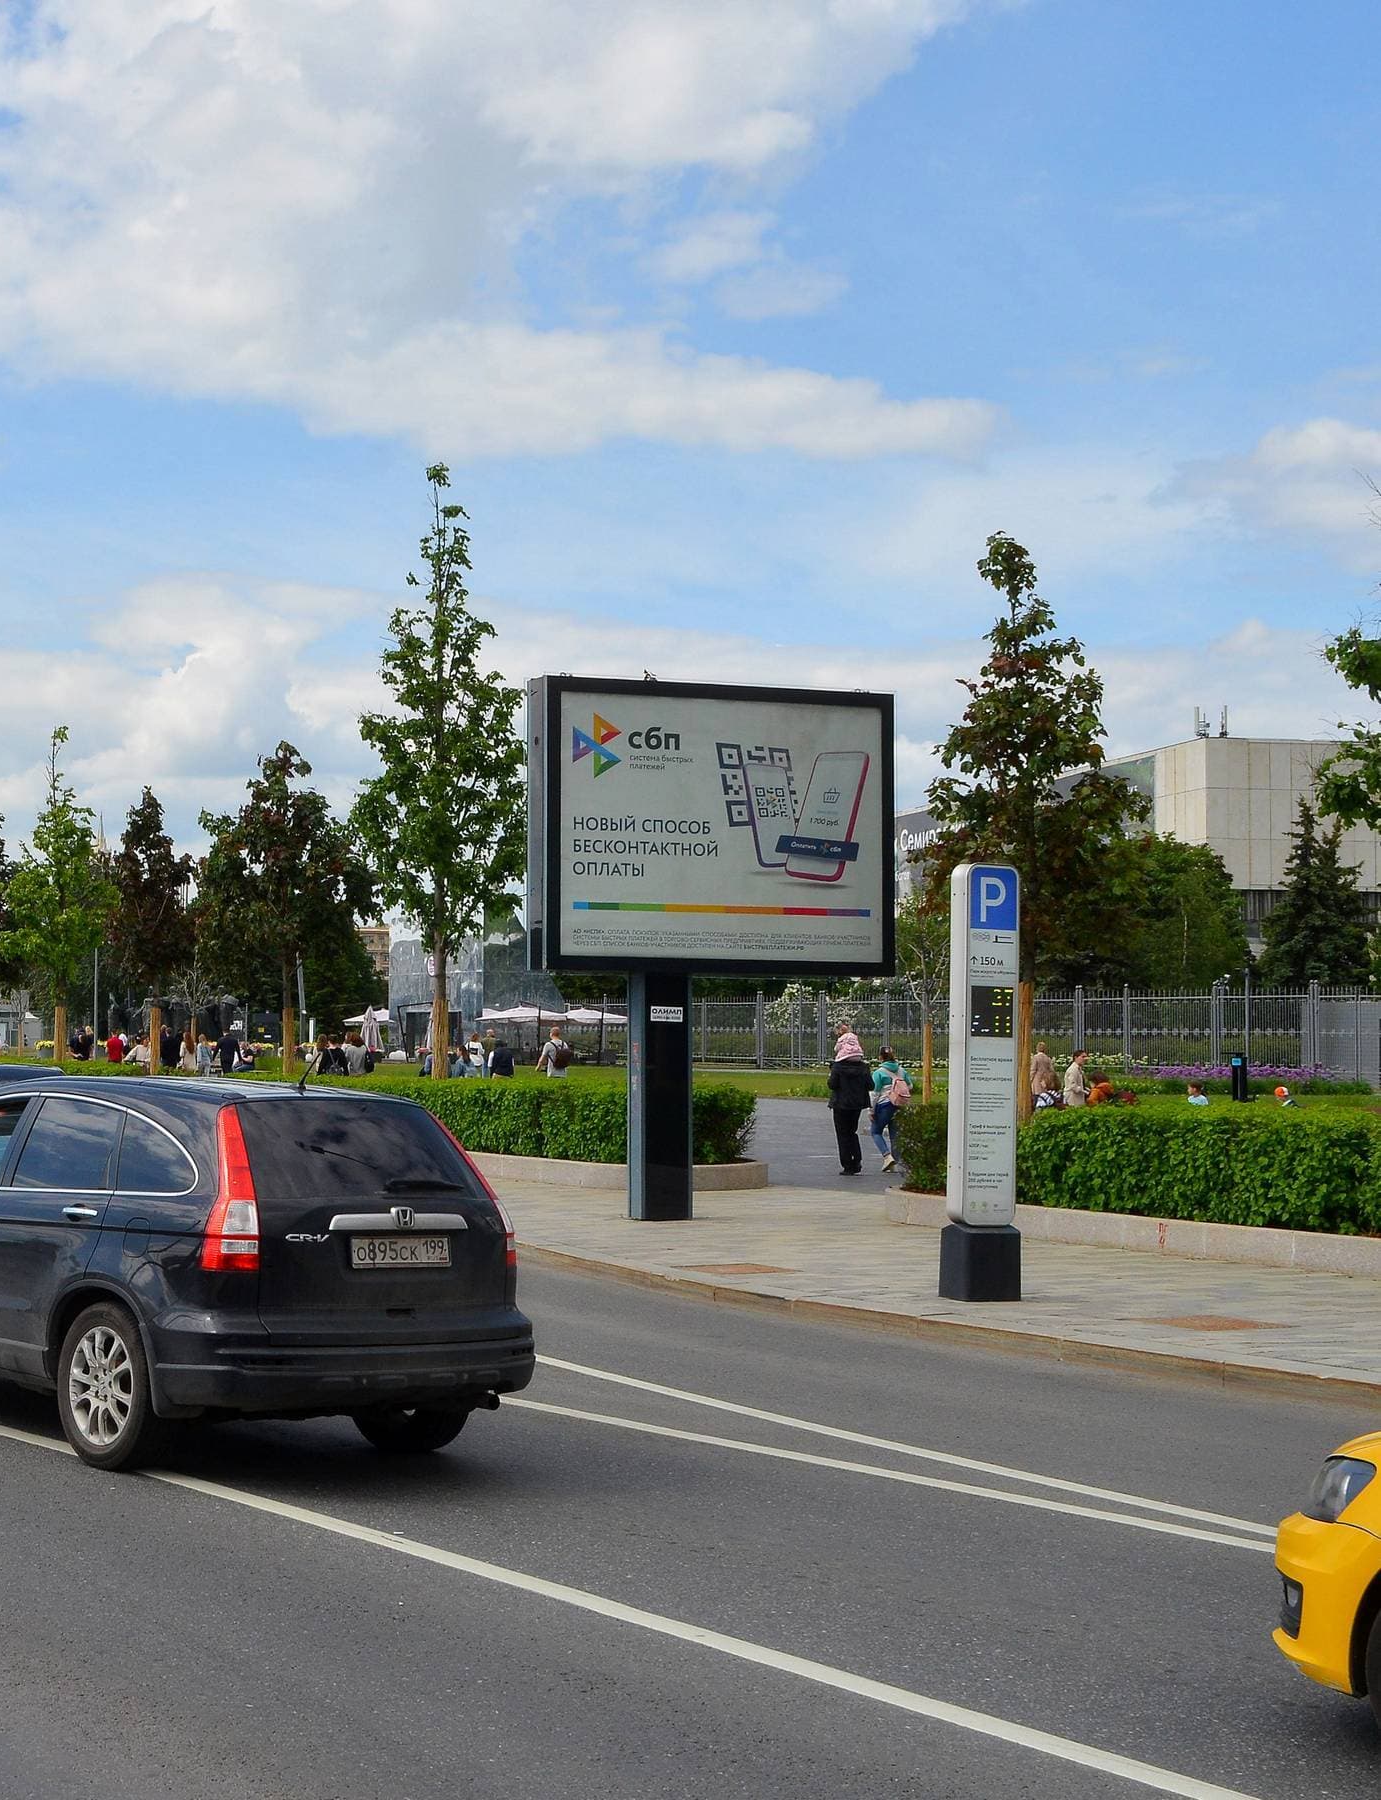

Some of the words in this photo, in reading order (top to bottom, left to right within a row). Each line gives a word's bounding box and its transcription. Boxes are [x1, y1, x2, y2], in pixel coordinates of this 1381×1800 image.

[628, 726, 680, 751] сбп
[573, 815, 636, 832] НОВЫЙ
[641, 819, 711, 835] СПОСОБ
[573, 839, 718, 857] БЕСКОНТАКТНОЙ
[572, 861, 645, 877] ОПЛАТЫ
[980, 876, 1006, 922] P
[980, 956, 996, 966] 150
[285, 1233, 330, 1243] CR-V
[356, 1240, 419, 1262] О895СК
[422, 1239, 444, 1255] 199
